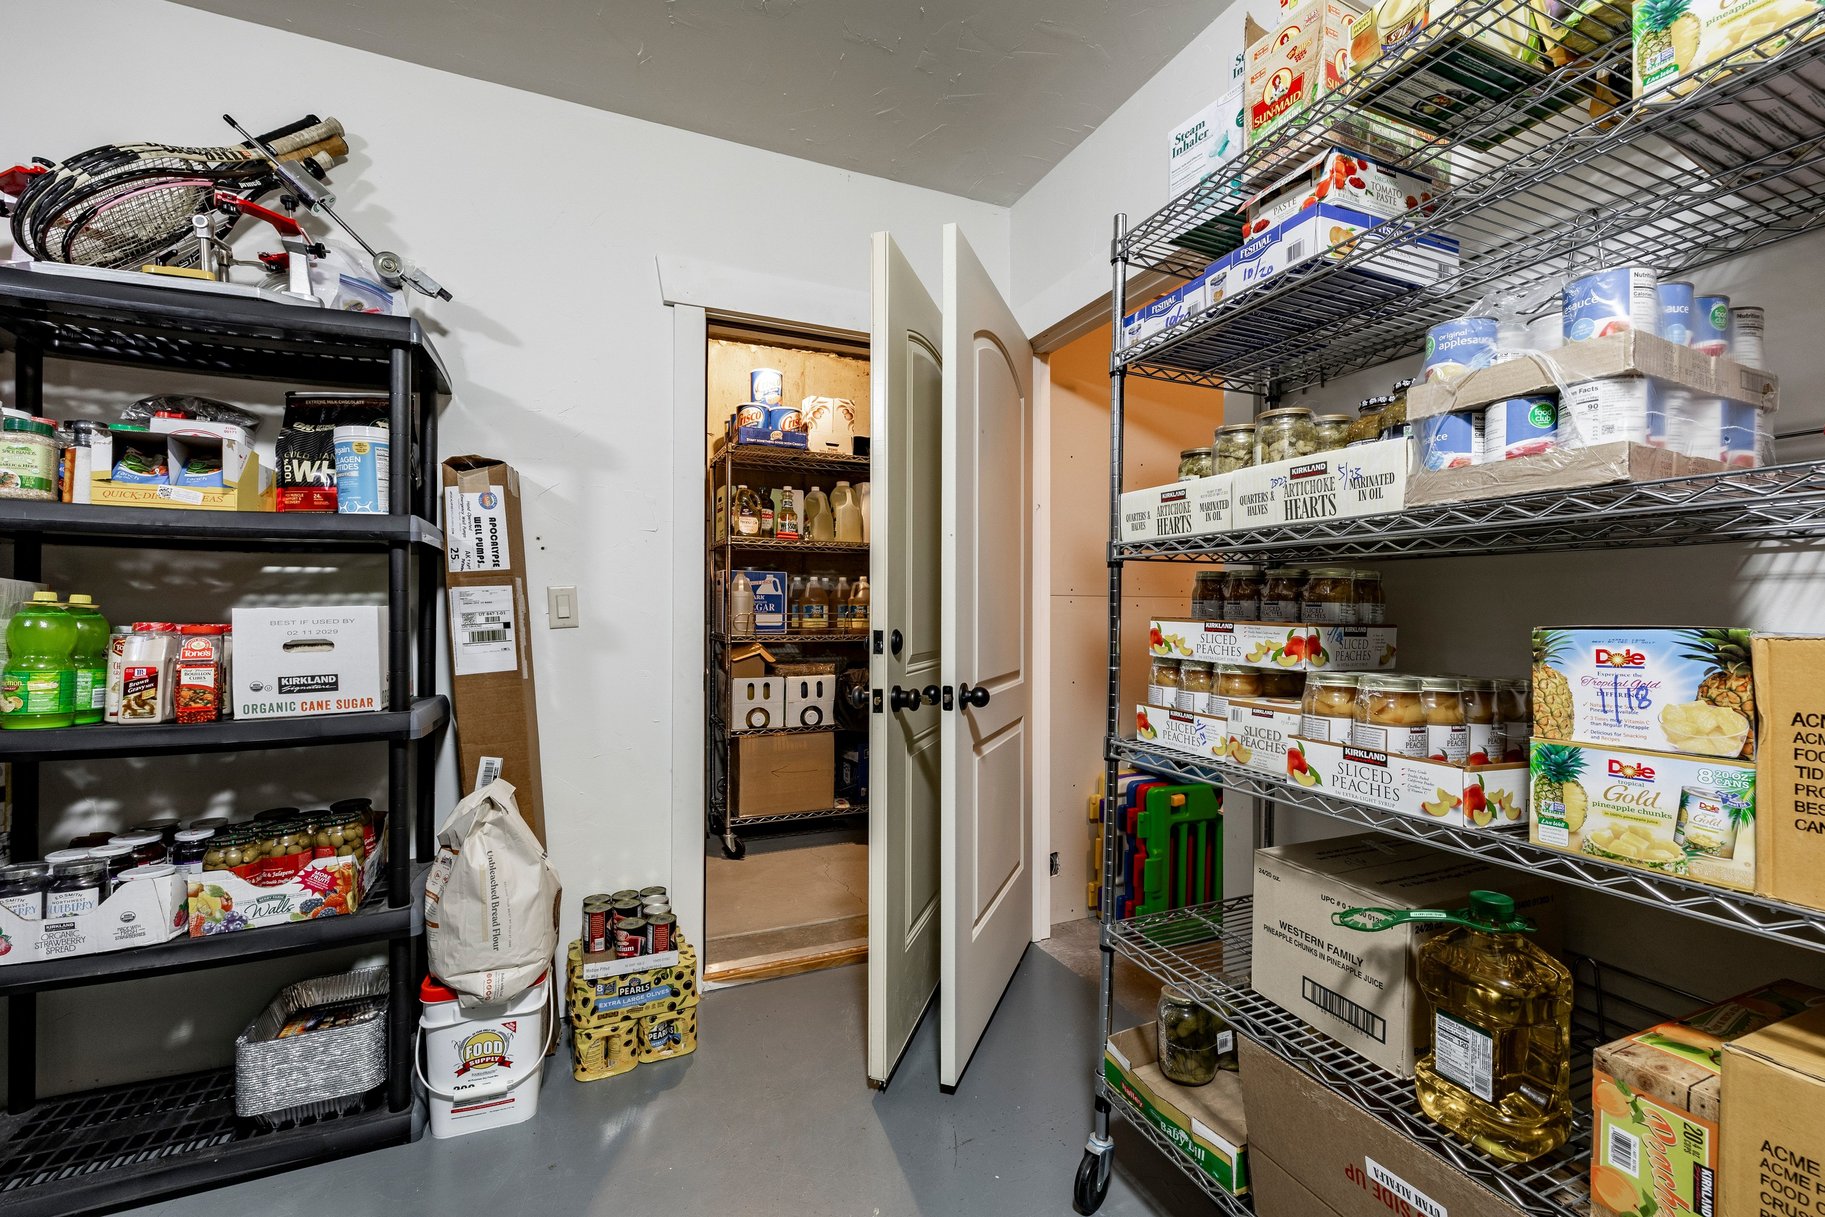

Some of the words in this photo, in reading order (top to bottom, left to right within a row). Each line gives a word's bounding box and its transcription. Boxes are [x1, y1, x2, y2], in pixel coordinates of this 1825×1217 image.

[1174, 119, 1206, 146] Steam
[1172, 128, 1210, 160] Inhaler
[1371, 180, 1403, 199] TOMATO
[1376, 188, 1398, 206] PASTE
[1273, 197, 1298, 216] PASTE
[1240, 233, 1272, 259] FESTIVAL
[1151, 295, 1177, 314] FESTIVAL
[1438, 329, 1468, 342] original
[1534, 408, 1552, 418] food
[1587, 403, 1599, 411] 90
[1535, 414, 1552, 423] club
[1291, 463, 1327, 475] KIRKLAND
[1284, 476, 1336, 499] ARTICHOKE
[1350, 472, 1395, 490] MARINATED
[102, 488, 136, 500] QUICK
[1239, 492, 1269, 506] QUARTERS
[1270, 490, 1276, 502] &
[1358, 489, 1367, 502] IN
[1369, 487, 1384, 499] OIL
[1156, 501, 1192, 518] ARTICHOKE
[1199, 499, 1230, 513] MARINATED
[1247, 503, 1268, 516] HALVES
[1284, 493, 1337, 521] HEARTS
[1125, 511, 1147, 523] QUARTERS
[1157, 514, 1193, 536] HEARTS
[1205, 512, 1212, 522] IN
[1212, 511, 1222, 521] OIL
[473, 516, 483, 535] WELL
[1131, 521, 1146, 531] HALVES
[475, 537, 485, 564] PUMPS
[489, 517, 500, 567] APOCALYPSE
[450, 547, 460, 560] 25
[1205, 622, 1233, 630] KIRKLAND
[1200, 633, 1237, 645] SLICED
[1339, 639, 1369, 650] SLICED
[1196, 643, 1242, 657] PEACHES
[1335, 650, 1372, 661] PEACHES
[1596, 648, 1646, 666] Dole
[128, 679, 150, 688] Brown
[281, 675, 337, 686] KIRKLAND
[1581, 675, 1629, 688] Tropical
[1630, 679, 1662, 692] Gold
[127, 685, 145, 694] Gravy
[243, 701, 296, 715] ORGANIC
[301, 700, 331, 712] CANE
[336, 697, 374, 710] SUGAR
[1165, 720, 1197, 736] SLICED
[1244, 725, 1282, 742] SLICED
[1162, 730, 1201, 747] PEACHES
[1241, 735, 1288, 755] PEACHES
[1344, 747, 1387, 762] KIRKLAND
[1337, 761, 1393, 785] SLICED
[1608, 758, 1656, 780] Dole
[1697, 768, 1714, 784] 8
[1714, 770, 1731, 779] 20
[1332, 774, 1400, 802] PEACHES
[1617, 779, 1645, 788] tropical
[1714, 779, 1750, 789] CANS
[1342, 791, 1358, 800] EXTRA
[1359, 795, 1377, 804] LIGHT
[1378, 799, 1396, 808] SYRUP
[1603, 784, 1661, 809] Gold
[1592, 800, 1636, 814] pineapple
[1637, 807, 1673, 820] chunks
[1699, 801, 1720, 812] Dole
[1693, 813, 1722, 827] Gold
[314, 870, 332, 880] MORE
[486, 850, 497, 902] Unbleached
[1272, 874, 1282, 883] oz.
[52, 897, 86, 905] NORTHWEST
[1320, 893, 1335, 905] UPC
[491, 902, 500, 928] Bread
[34, 936, 87, 950] STRAWBERRY
[41, 930, 80, 941] ORGANIC
[491, 929, 500, 951] Flour
[1279, 919, 1325, 950] WESTERN
[1327, 943, 1364, 968] FAMILY
[46, 945, 77, 955] SPREAD
[1263, 923, 1293, 945] PINEAPPLE
[1293, 938, 1318, 957] CHUNKS
[1318, 951, 1326, 961] IN
[1326, 954, 1363, 979] PINEAPPLE
[1363, 974, 1384, 990] JUICE
[597, 984, 603, 992] 8
[619, 983, 650, 996] PEARLS
[599, 1000, 621, 1009] EXTRA
[622, 995, 646, 1003] LARGE
[646, 988, 670, 998] OLIVES
[465, 1040, 503, 1060] FOOD
[1457, 1039, 1470, 1050] 120
[468, 1056, 500, 1066] SUPPLY
[1160, 1120, 1189, 1147] Baby
[1188, 1141, 1206, 1162] Dill
[1683, 1121, 1704, 1145] 20
[1761, 1140, 1821, 1178] ACME
[1345, 1163, 1367, 1191] UP
[1760, 1158, 1812, 1192] ACME
[1372, 1166, 1412, 1202] ALFALFA
[1701, 1168, 1713, 1217] KIRKLAND
[1760, 1173, 1810, 1208] FOOD
[1414, 1192, 1441, 1217] UTAH
